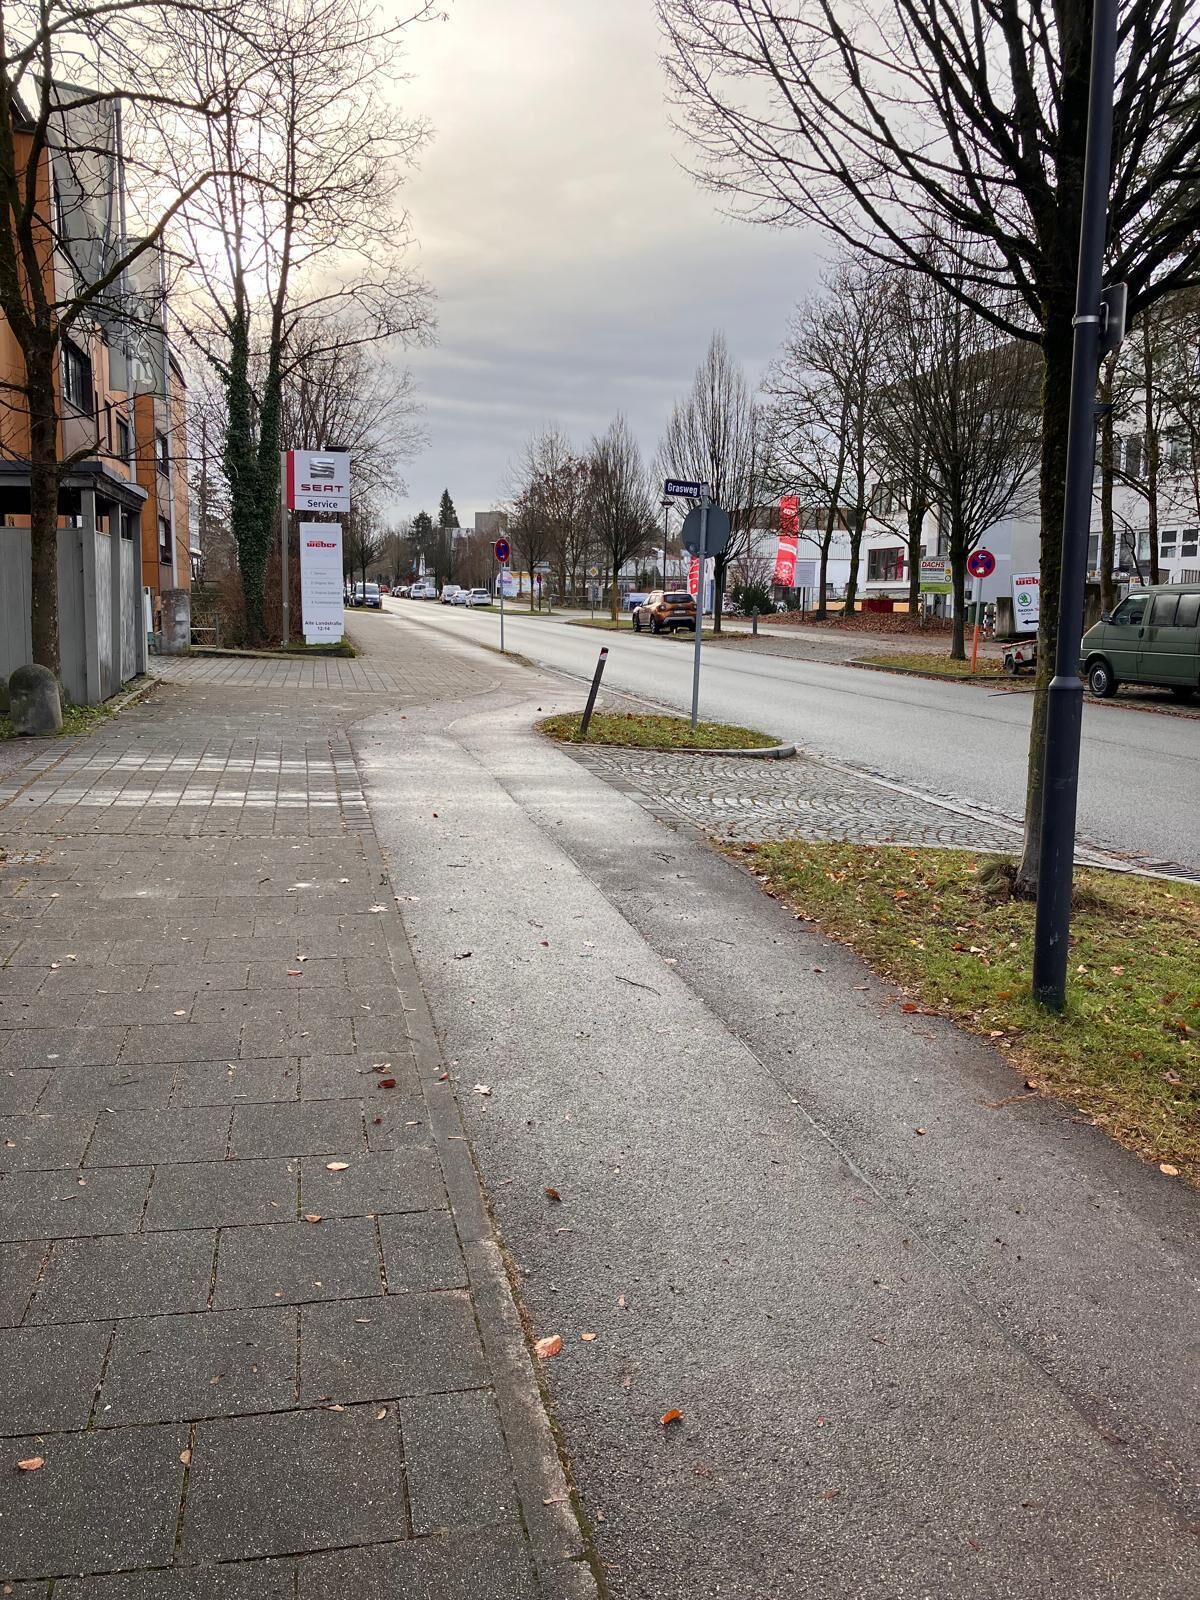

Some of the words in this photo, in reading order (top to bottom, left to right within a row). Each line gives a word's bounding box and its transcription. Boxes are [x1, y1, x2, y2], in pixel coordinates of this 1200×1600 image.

[301, 484, 344, 493] SEAT
[667, 482, 698, 496] Grasweg
[307, 499, 338, 509] Service
[306, 540, 337, 548] weber
